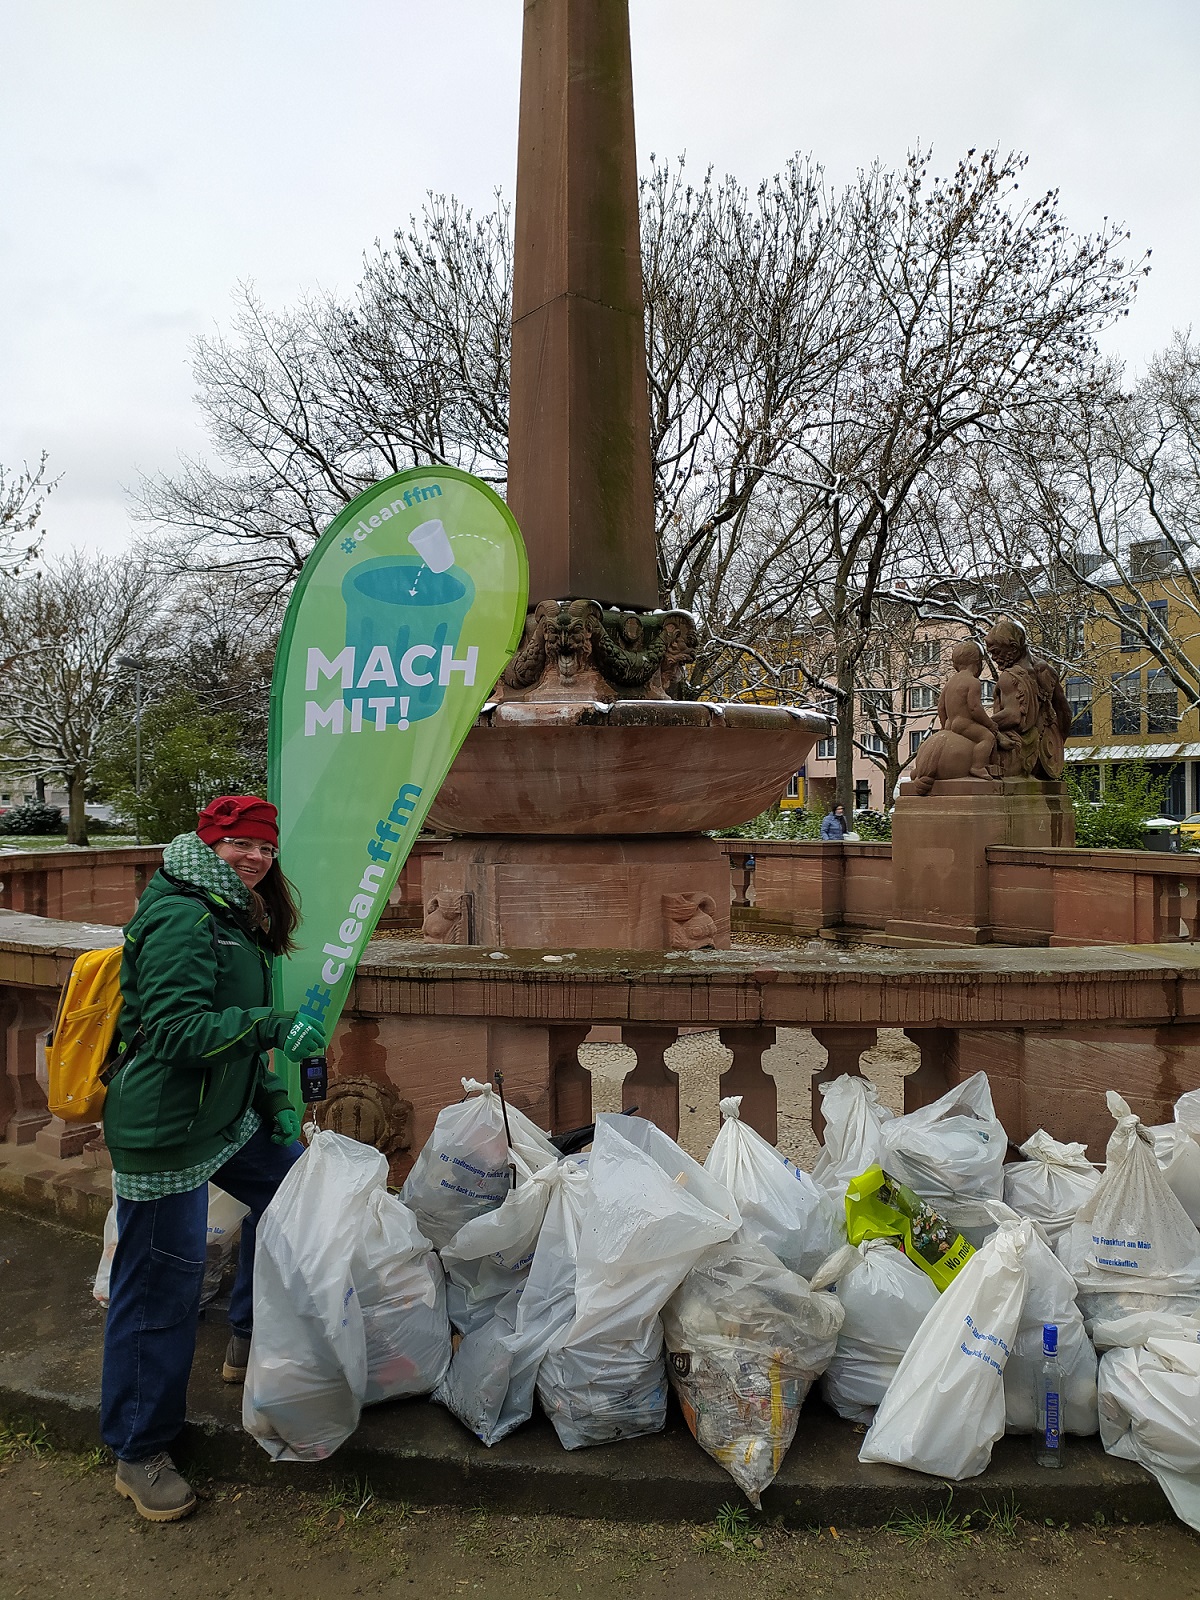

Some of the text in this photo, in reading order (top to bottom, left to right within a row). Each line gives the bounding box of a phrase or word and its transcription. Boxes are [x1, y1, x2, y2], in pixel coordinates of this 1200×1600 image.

[340, 484, 443, 554] #cleanffm
[304, 644, 479, 691] MACH
[304, 696, 411, 737] MIT!
[300, 783, 423, 1021] #cleanffm
[440, 1153, 450, 1163] FES
[440, 1179, 456, 1190] Dieser
[456, 1185, 469, 1195] Sack
[1100, 1236, 1126, 1248] Frankfurt
[1126, 1241, 1137, 1249] am
[943, 1257, 961, 1271] Wo
[1047, 1398, 1059, 1430] VODKA
